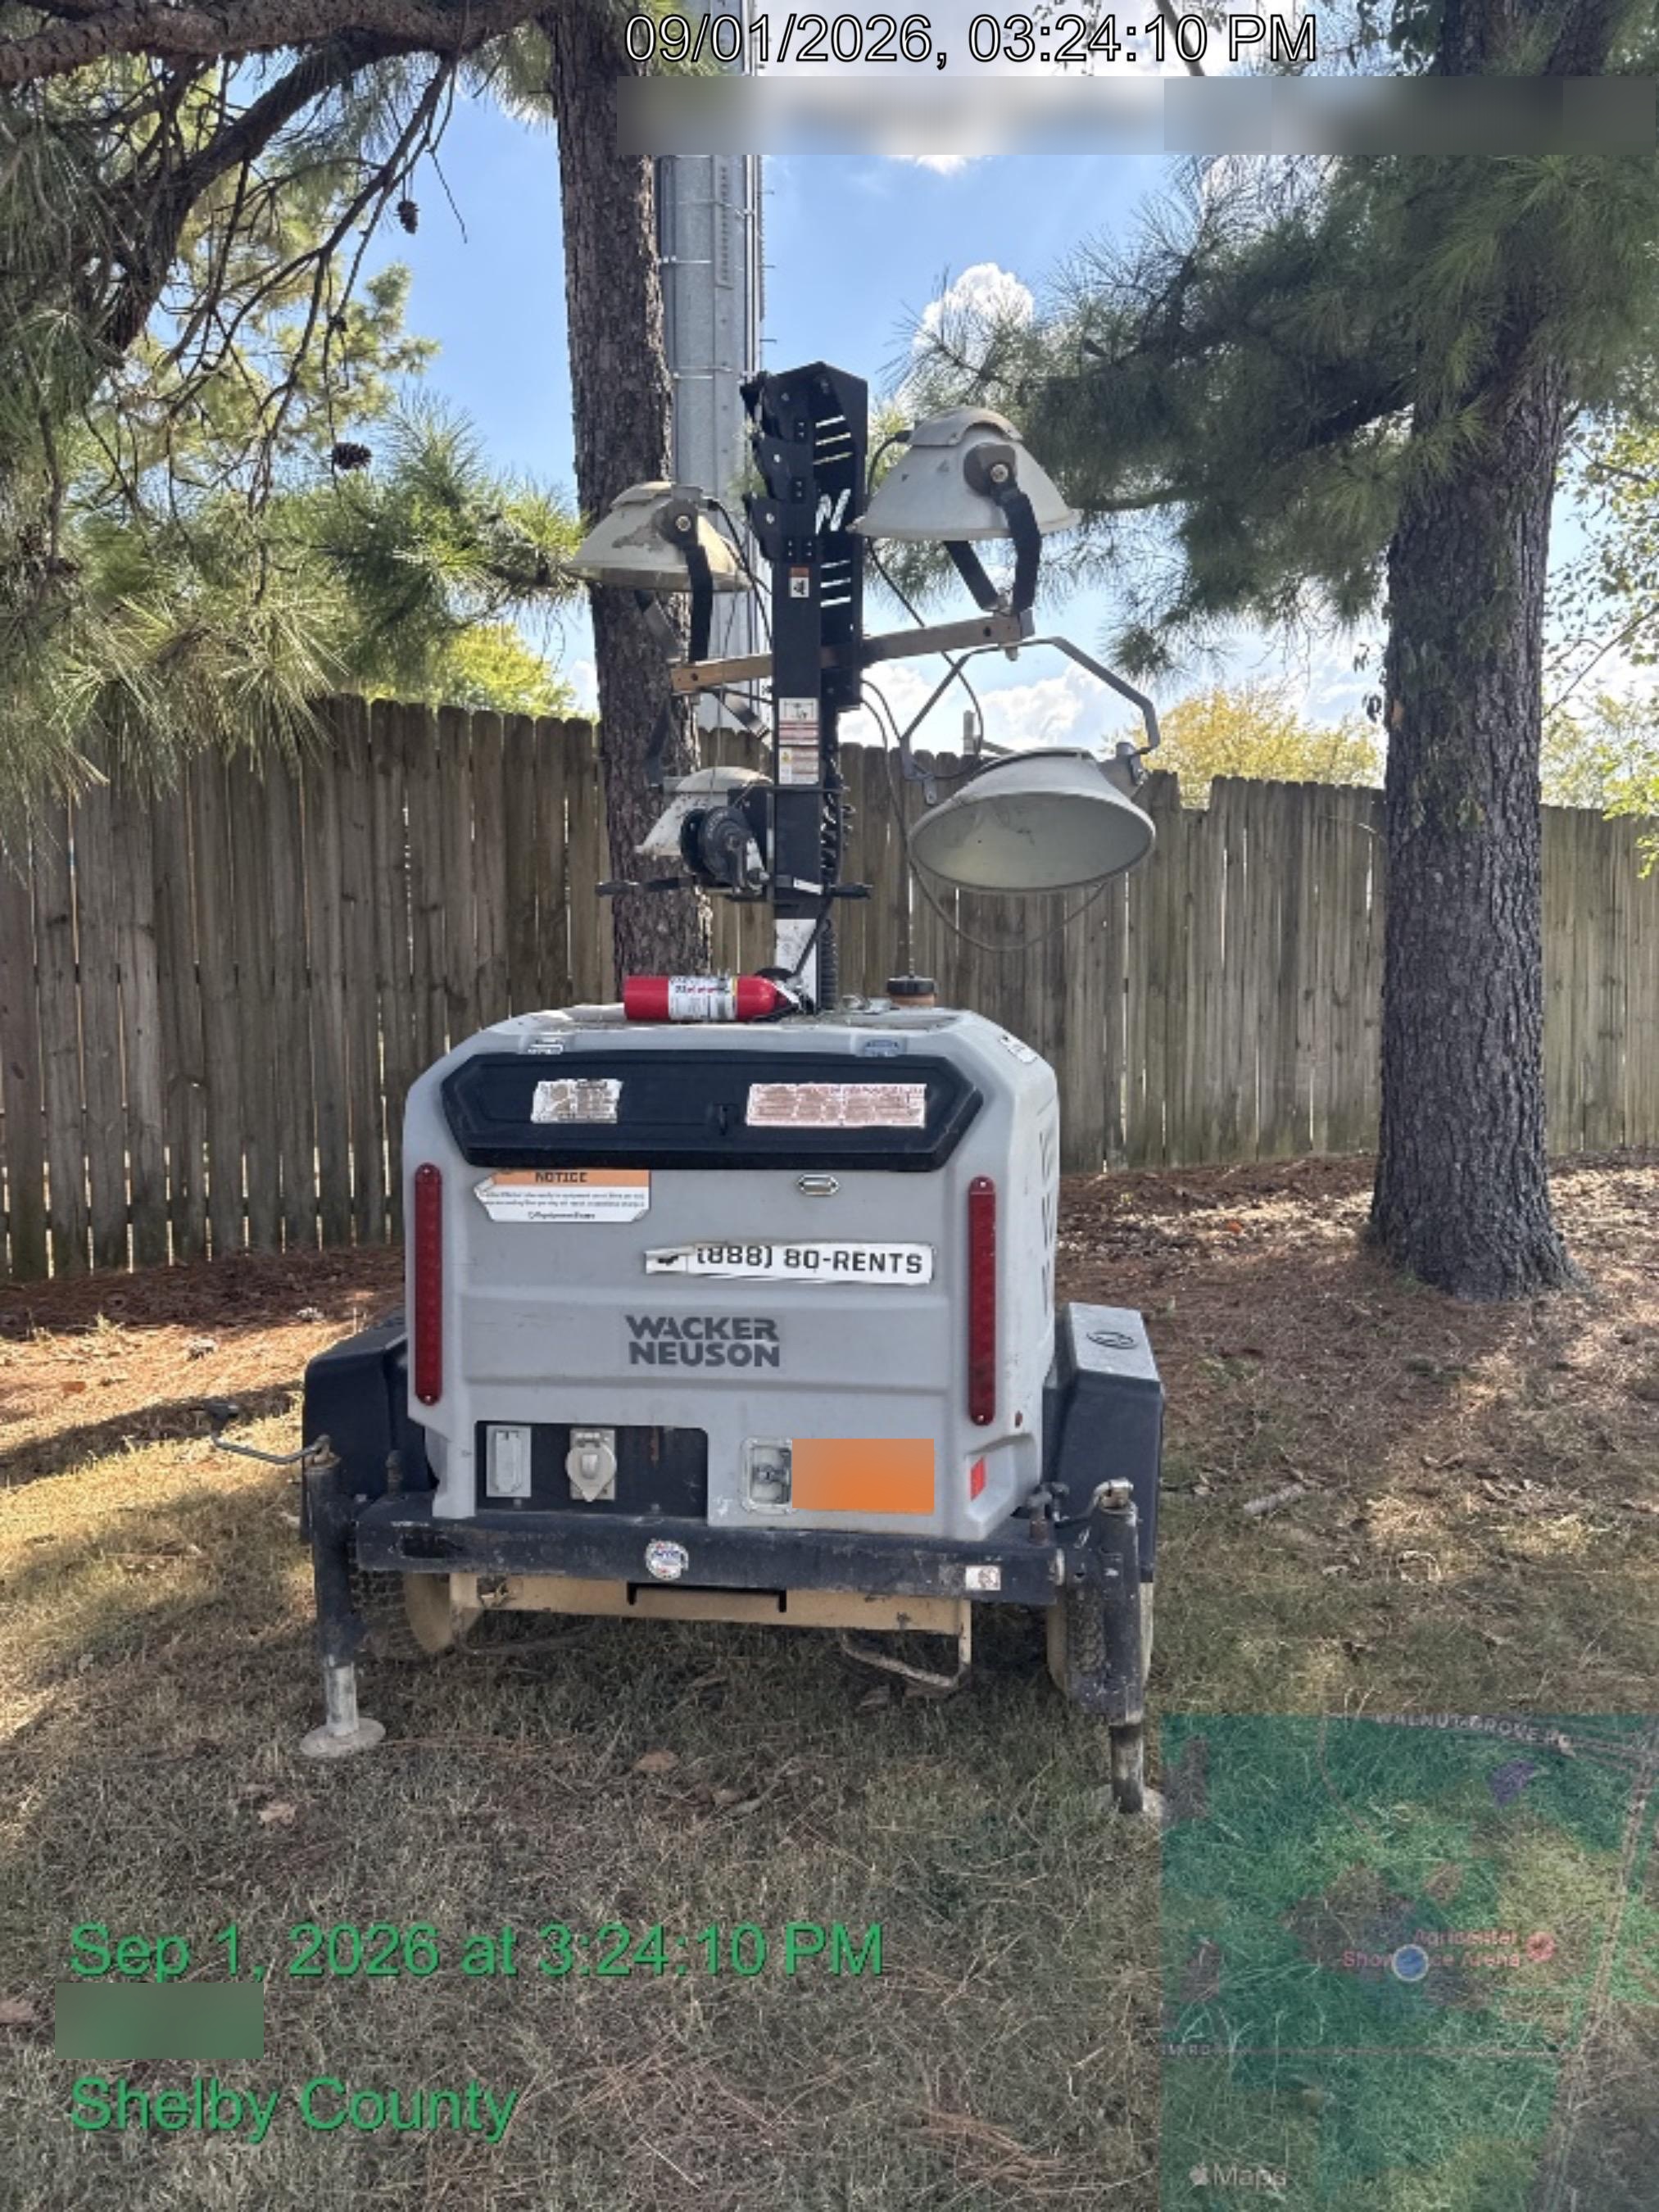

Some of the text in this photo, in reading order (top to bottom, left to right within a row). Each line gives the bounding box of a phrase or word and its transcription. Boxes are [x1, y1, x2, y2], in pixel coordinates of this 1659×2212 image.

[535, 1172, 587, 1183] NOTICE
[697, 1245, 922, 1274] (888) 80-RENTS
[625, 1314, 779, 1341] WACKER
[628, 1340, 780, 1367] NEUSON
